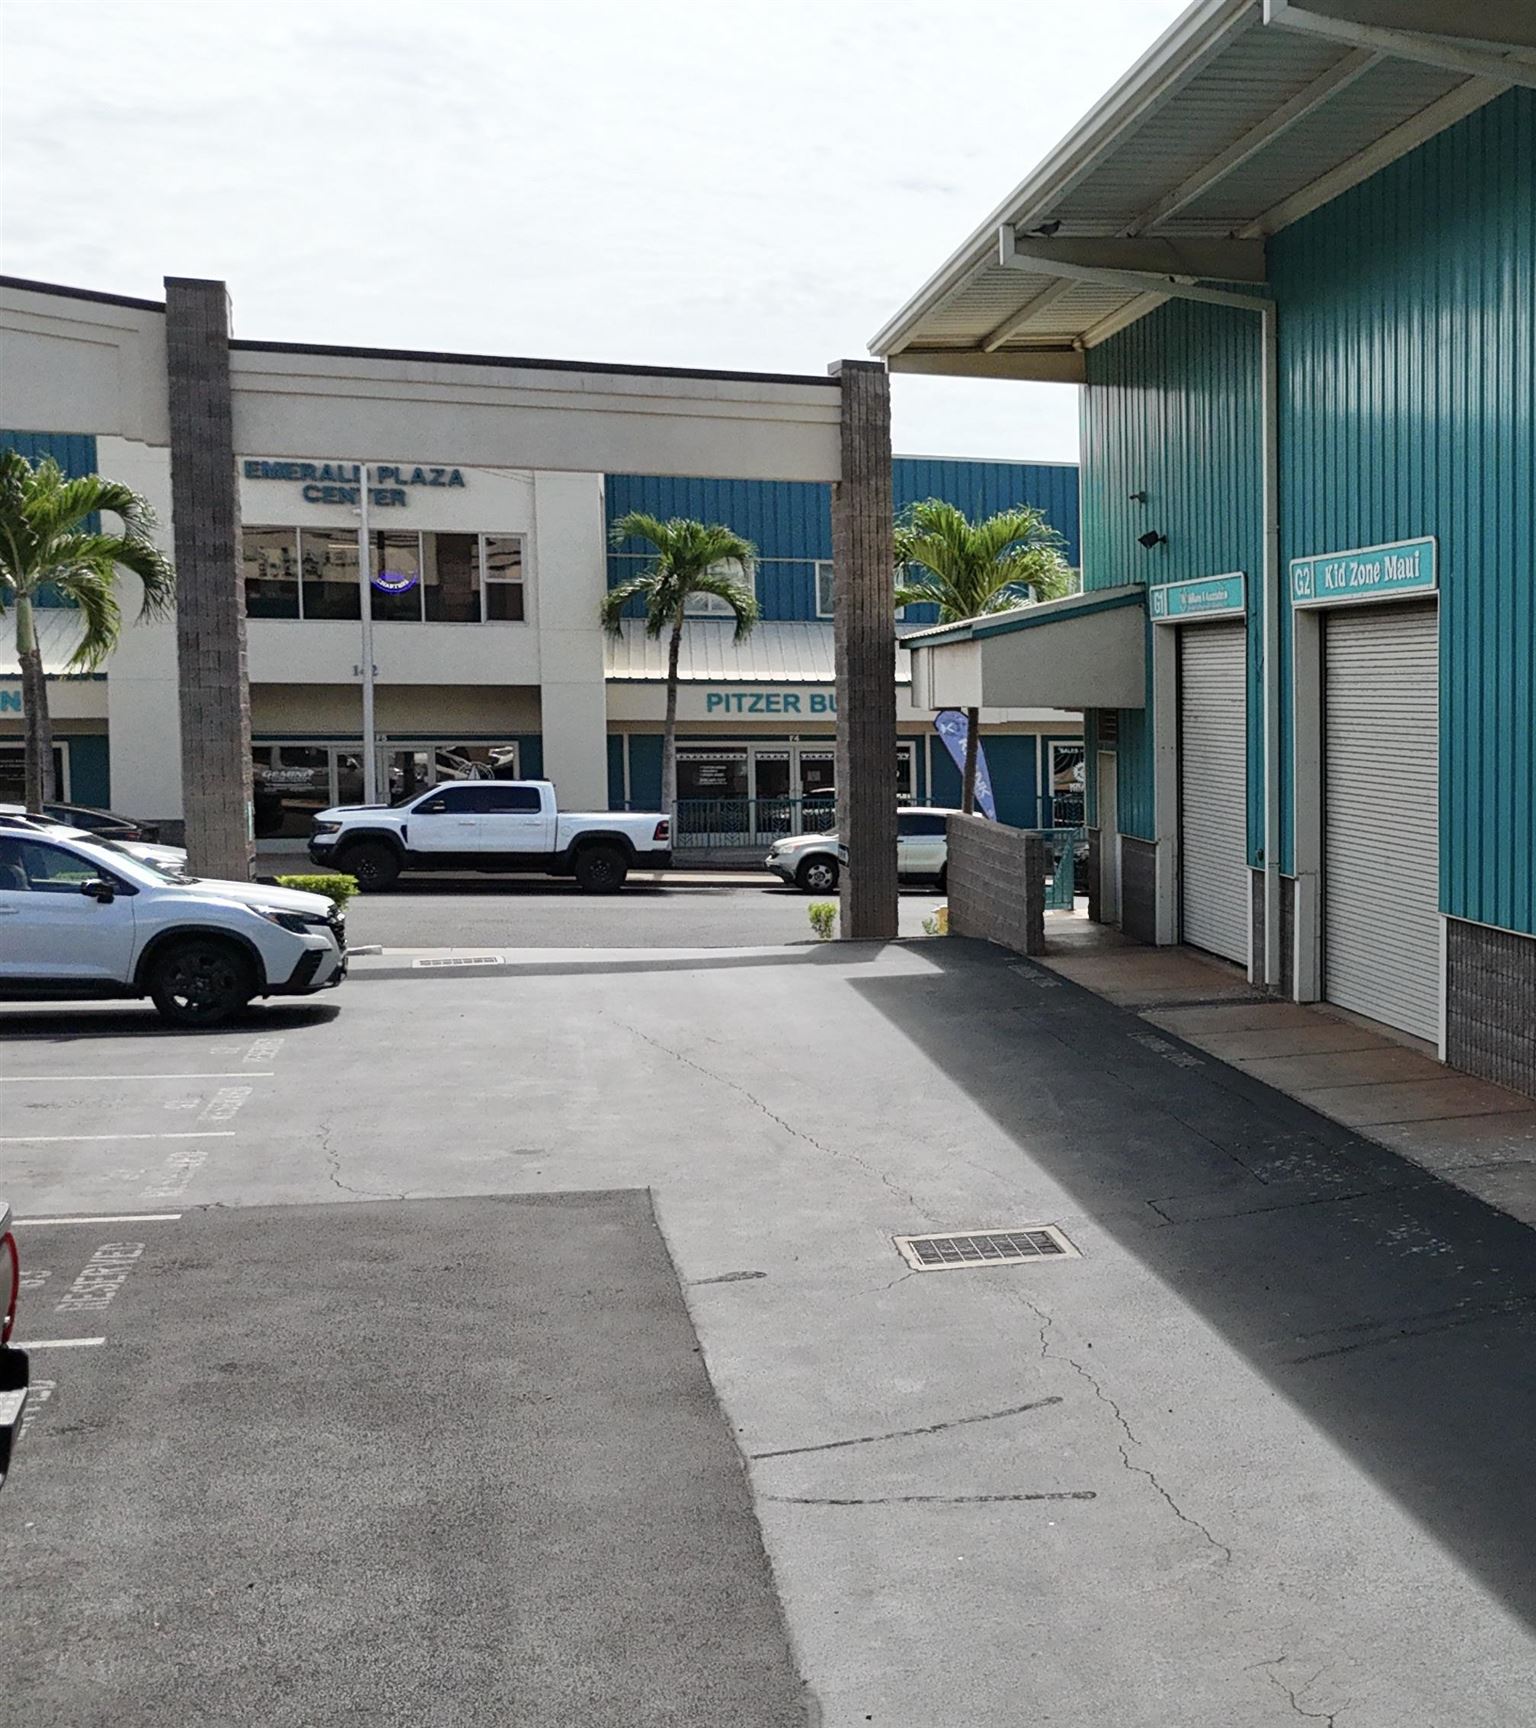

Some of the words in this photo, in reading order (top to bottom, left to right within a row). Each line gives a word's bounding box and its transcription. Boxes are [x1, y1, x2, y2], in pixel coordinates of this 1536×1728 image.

[375, 466, 464, 487] PLAZA
[1294, 567, 1311, 596] G2
[1324, 560, 1346, 590] Kid
[1349, 561, 1381, 588] Zone
[1384, 550, 1420, 582] Maui
[1153, 591, 1164, 614] G1
[352, 664, 379, 677] 12
[706, 692, 799, 714] PITZER
[55, 1241, 146, 1311] RESERVED
